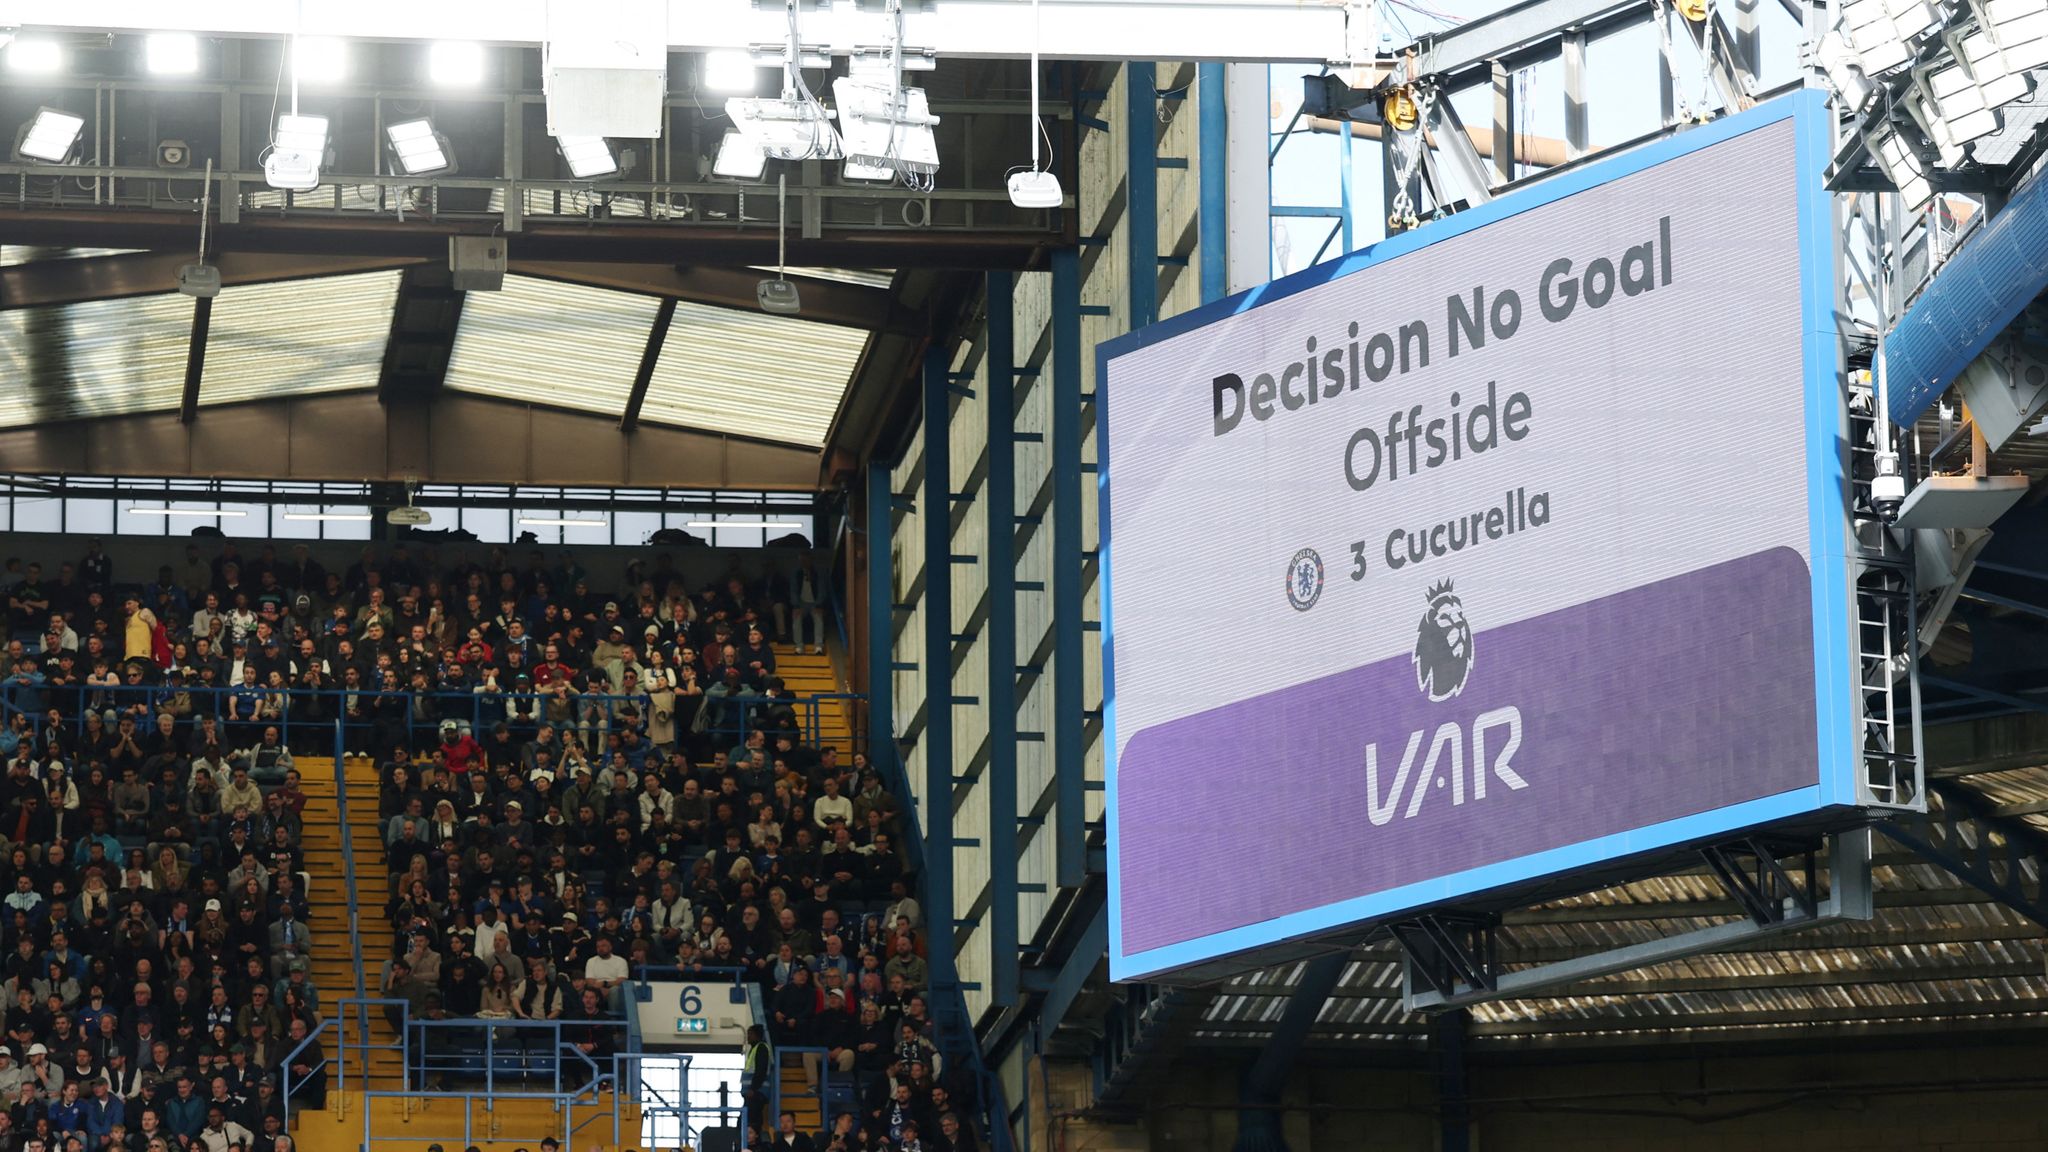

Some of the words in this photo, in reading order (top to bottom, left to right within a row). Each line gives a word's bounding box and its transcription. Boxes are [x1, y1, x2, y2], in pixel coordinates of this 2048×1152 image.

[1213, 319, 1429, 437] Decision
[1447, 286, 1522, 358] No
[1539, 216, 1672, 323] Goal
[1344, 381, 1532, 492] Offside
[1292, 549, 1317, 566] CHELSEA
[1350, 541, 1367, 582] 3
[1385, 487, 1550, 569] Cucurella
[1365, 706, 1529, 826] VAR
[680, 985, 702, 1016] 6
